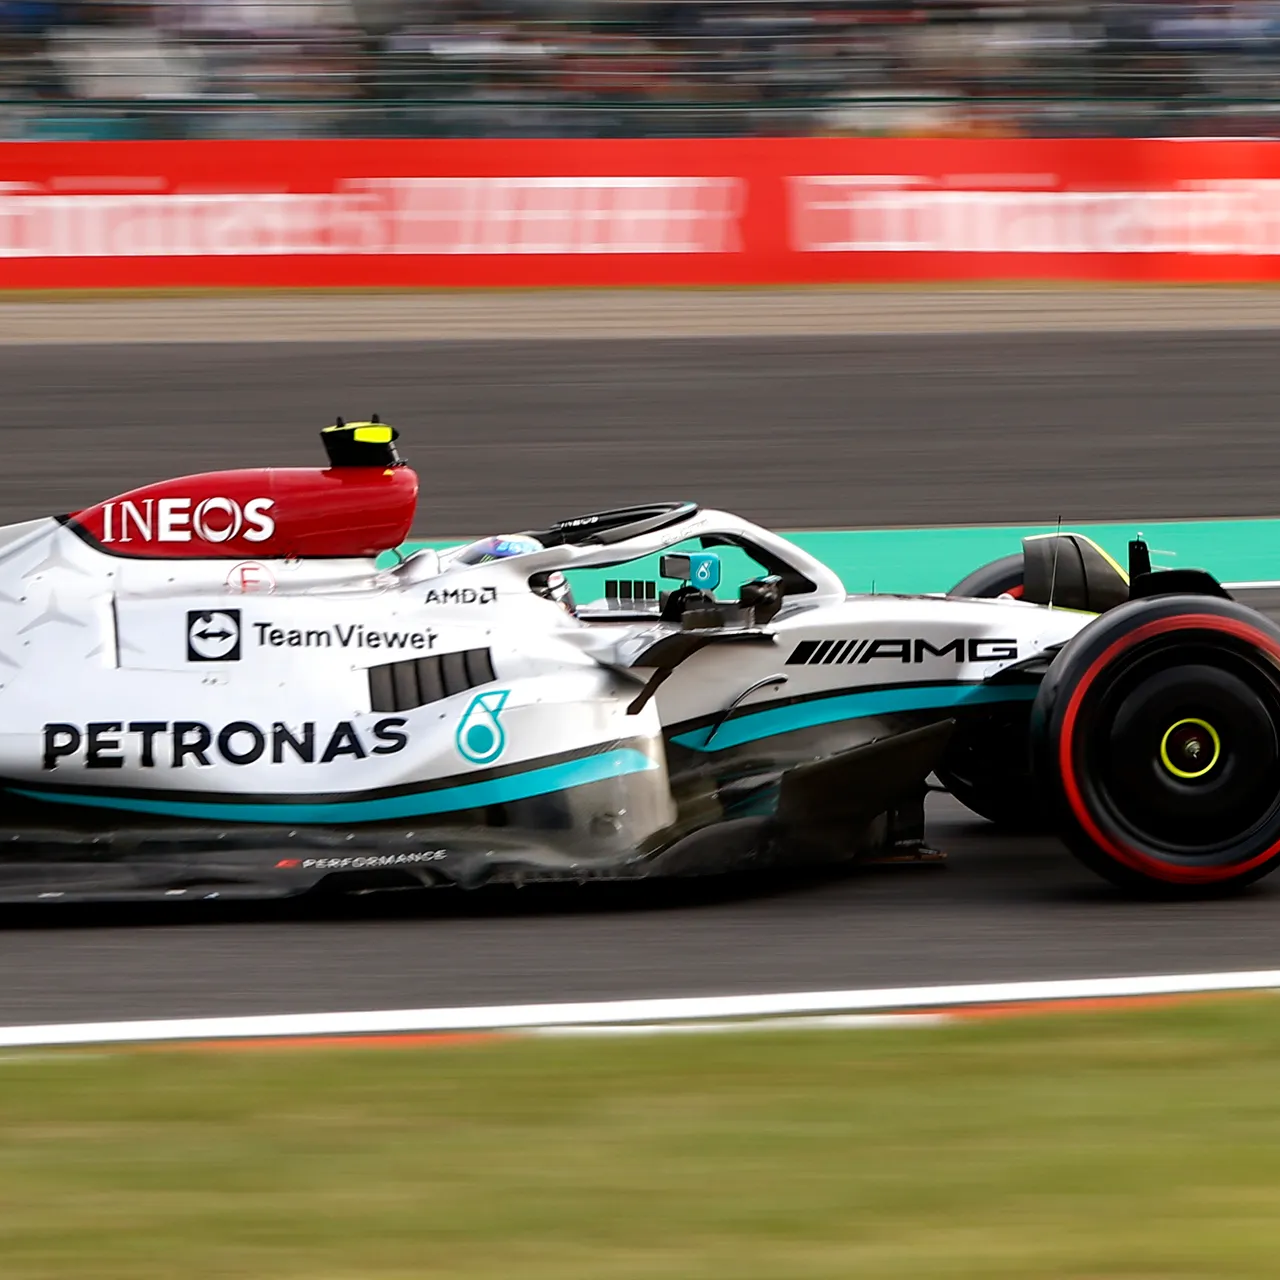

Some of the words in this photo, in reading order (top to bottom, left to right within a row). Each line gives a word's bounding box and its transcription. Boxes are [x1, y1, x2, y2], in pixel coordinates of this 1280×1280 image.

[101, 497, 276, 543] INEOS
[425, 588, 477, 605] AMD
[252, 622, 439, 649] TeamViewer
[857, 638, 1018, 664] AMG
[41, 716, 410, 770] PETRONAS
[302, 849, 448, 869] PERFORMANCE
